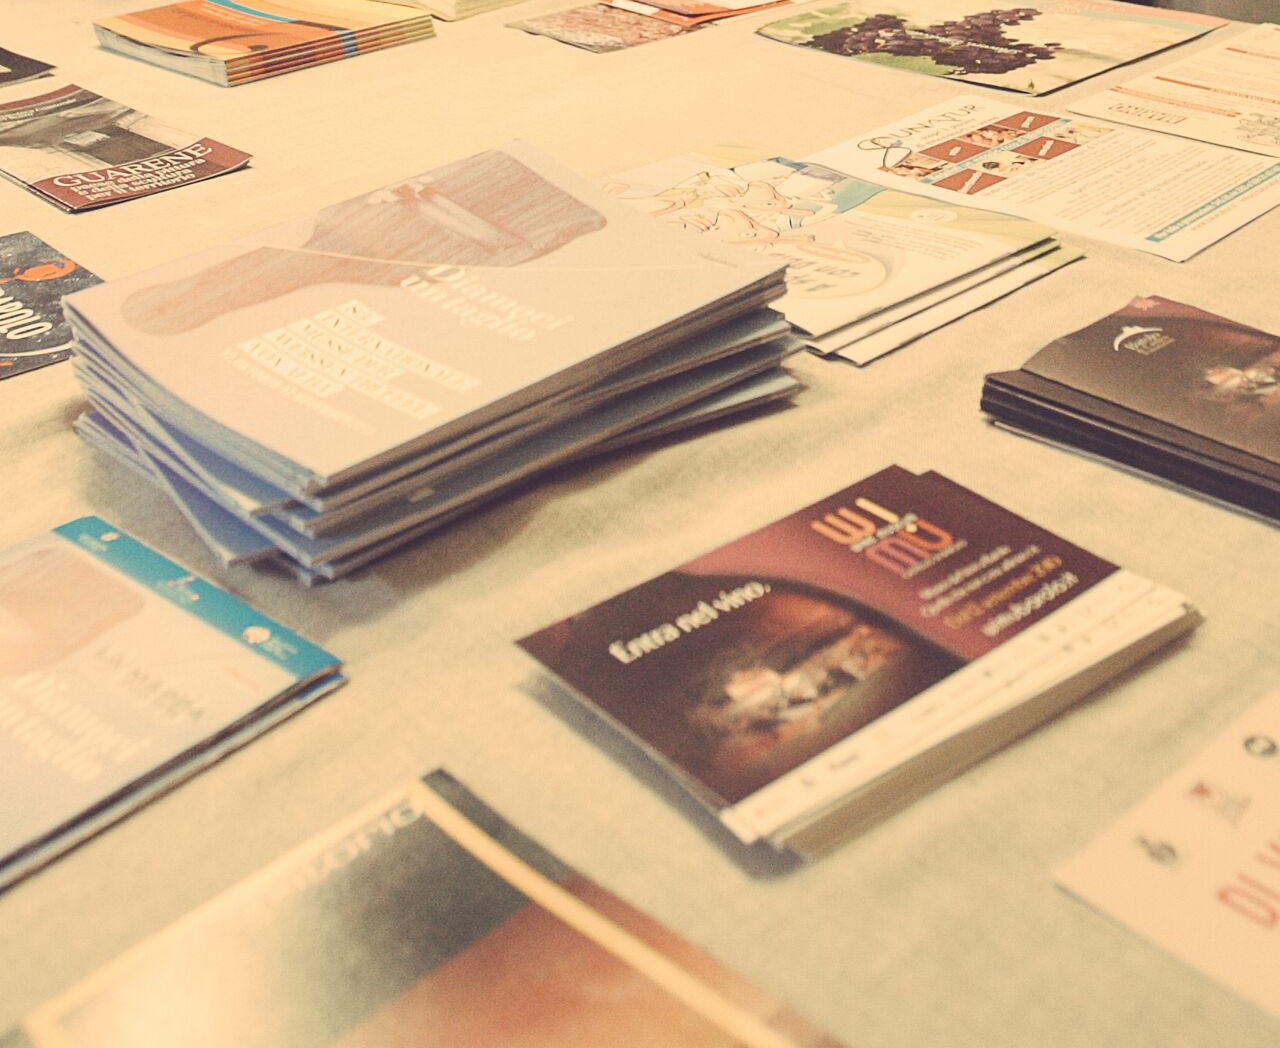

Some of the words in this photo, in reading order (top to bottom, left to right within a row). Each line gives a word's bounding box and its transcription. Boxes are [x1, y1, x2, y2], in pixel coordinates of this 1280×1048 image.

[53, 143, 212, 187] GUARENE
[70, 178, 114, 193] paese
[117, 166, 156, 184] della
[128, 173, 196, 193] territorio
[427, 264, 575, 331] Diamoci
[442, 293, 536, 342] taglio
[675, 601, 718, 634] nel
